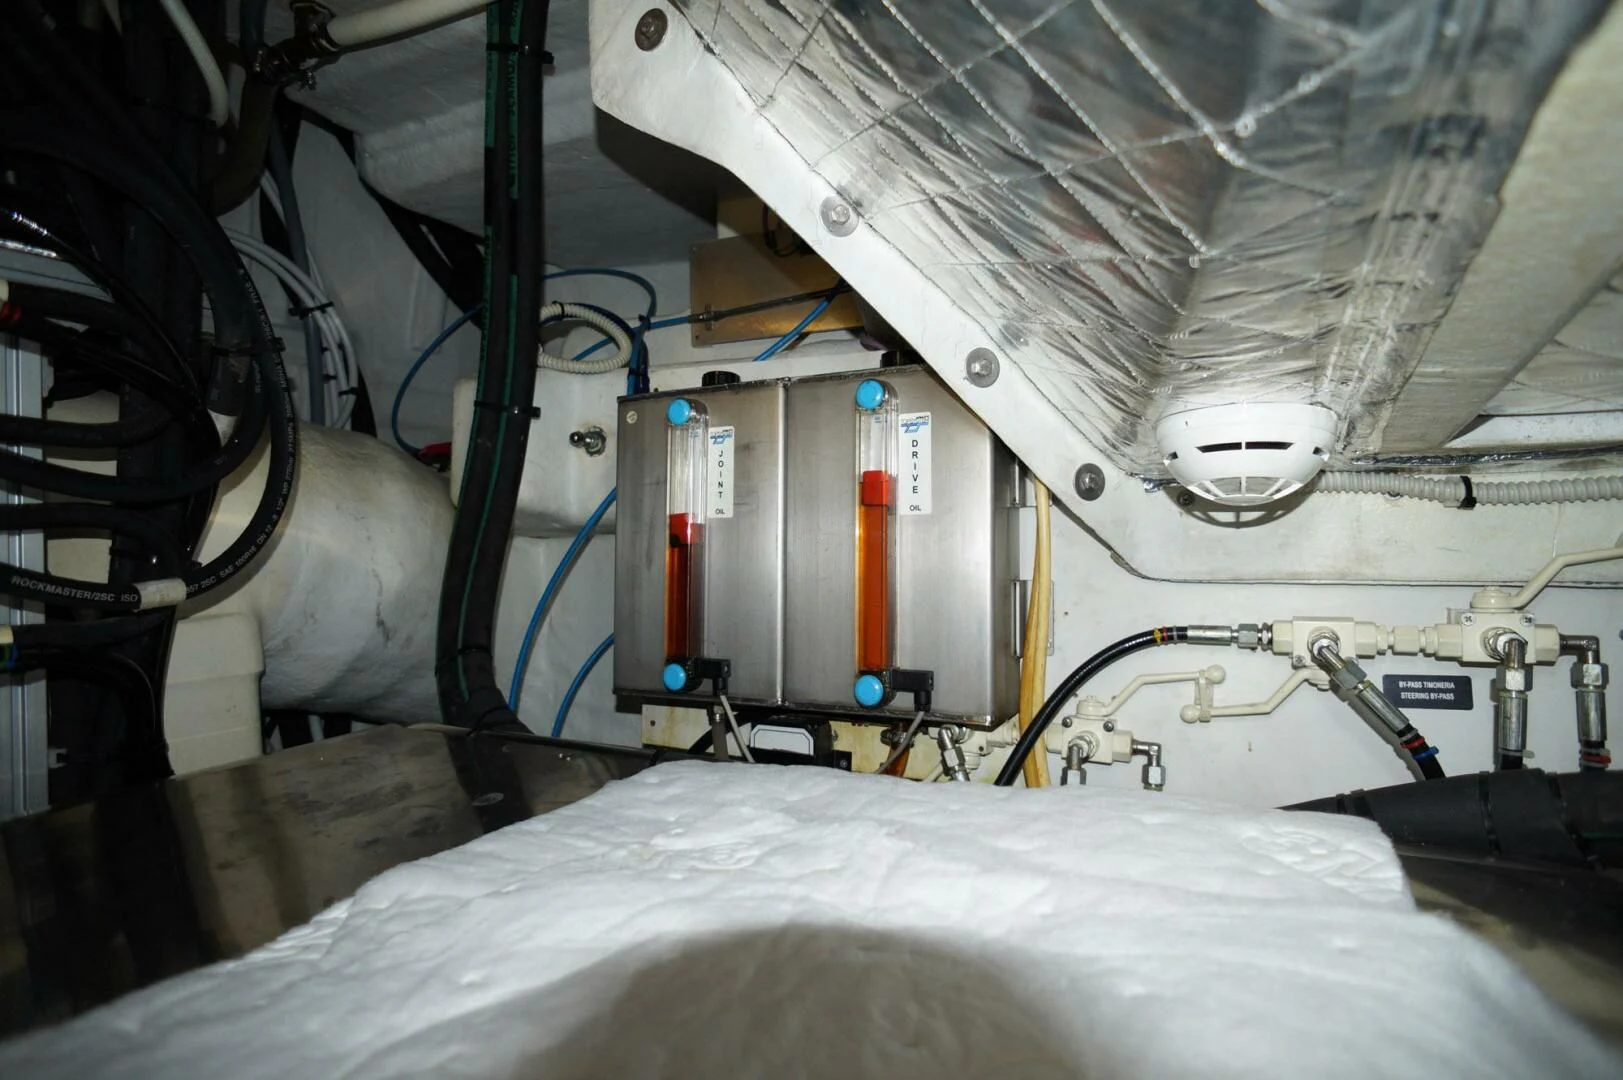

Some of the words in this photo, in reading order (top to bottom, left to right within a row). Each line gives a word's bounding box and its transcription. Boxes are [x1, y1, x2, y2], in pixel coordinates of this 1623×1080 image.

[911, 440, 919, 495] DRIVE
[715, 508, 726, 516] OIL
[909, 504, 922, 512] OIL
[11, 575, 116, 602] ROCKMASTER/2SC
[120, 593, 138, 602] ISO
[200, 576, 217, 588] 2SC
[220, 565, 235, 578] SAE
[1399, 681, 1423, 689] BY-PASS
[1423, 681, 1455, 689] TIMONERIA
[1400, 692, 1430, 700] STEERING
